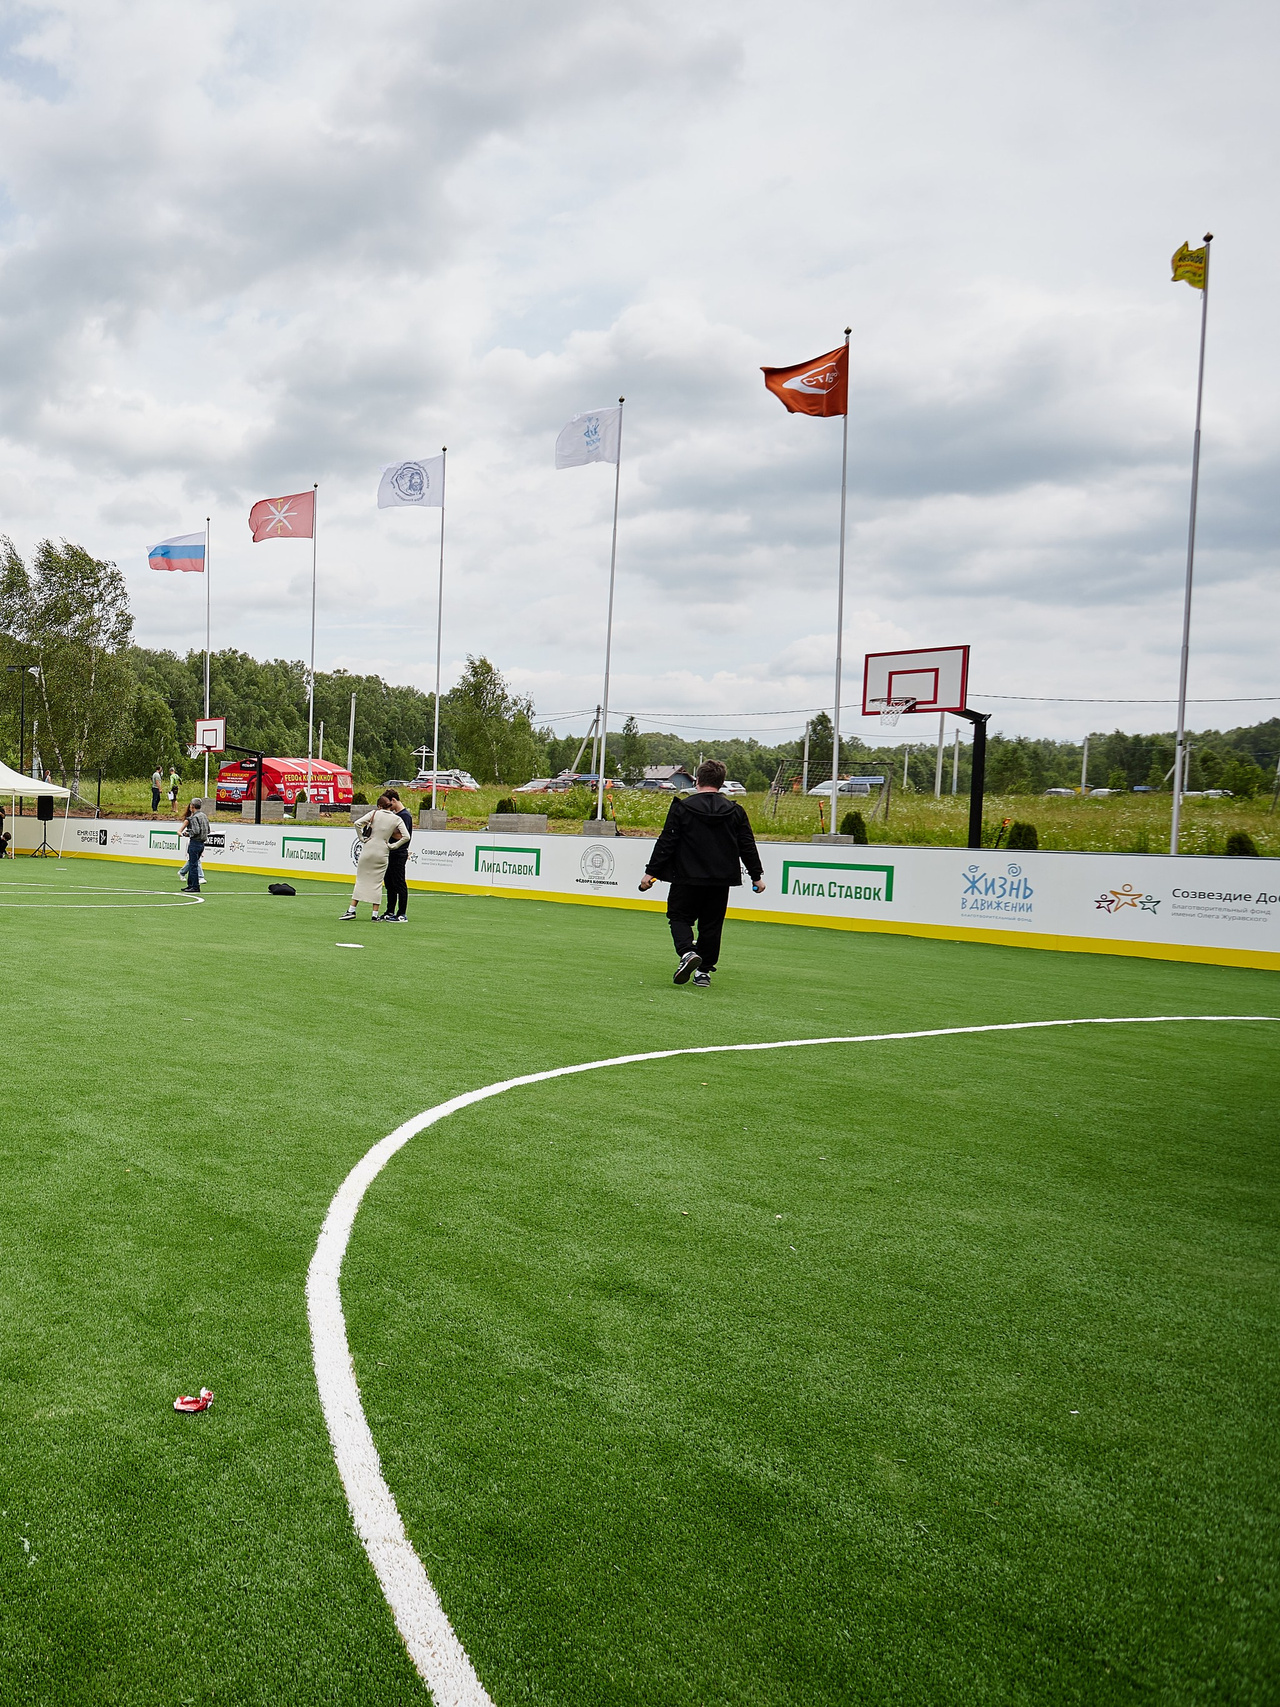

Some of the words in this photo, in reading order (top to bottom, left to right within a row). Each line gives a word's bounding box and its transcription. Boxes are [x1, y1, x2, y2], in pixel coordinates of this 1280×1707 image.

[213, 837, 224, 846] PRO
[421, 848, 448, 856] Созвездие
[961, 872, 1034, 900] ЖИЗНЬ
[1172, 888, 1252, 903] Созвездие
[1255, 892, 1280, 905] До
[961, 897, 968, 910] В
[969, 898, 1033, 913] ДВИЖЕНИИ
[1171, 903, 1248, 914] Благотворительный
[1197, 912, 1220, 920] Олега
[1221, 914, 1268, 922] Журавского
